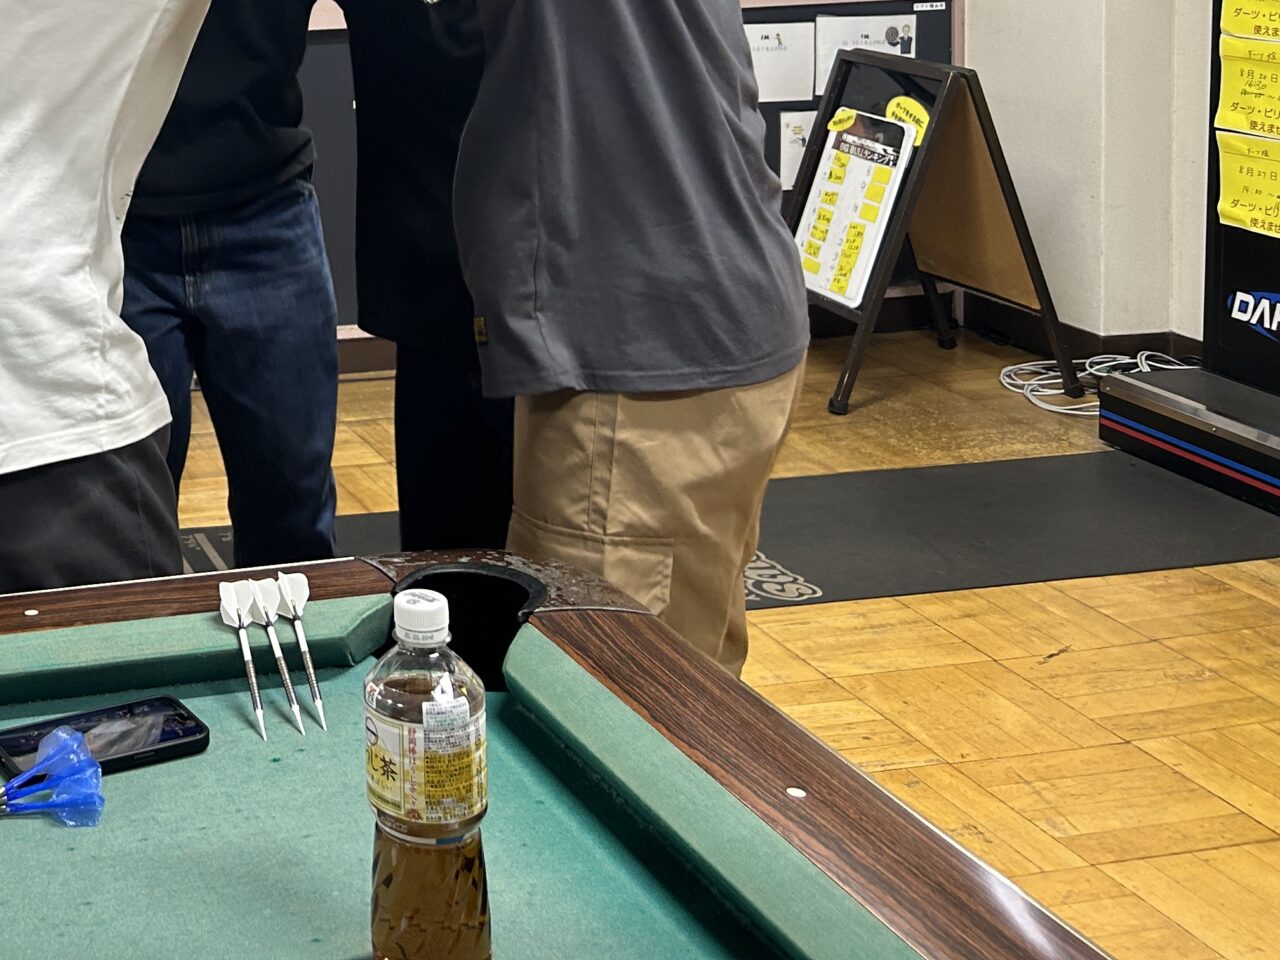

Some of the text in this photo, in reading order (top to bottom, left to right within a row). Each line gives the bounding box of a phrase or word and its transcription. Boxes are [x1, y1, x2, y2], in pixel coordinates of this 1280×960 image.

[1233, 7, 1280, 22] ダーツ・ビ
